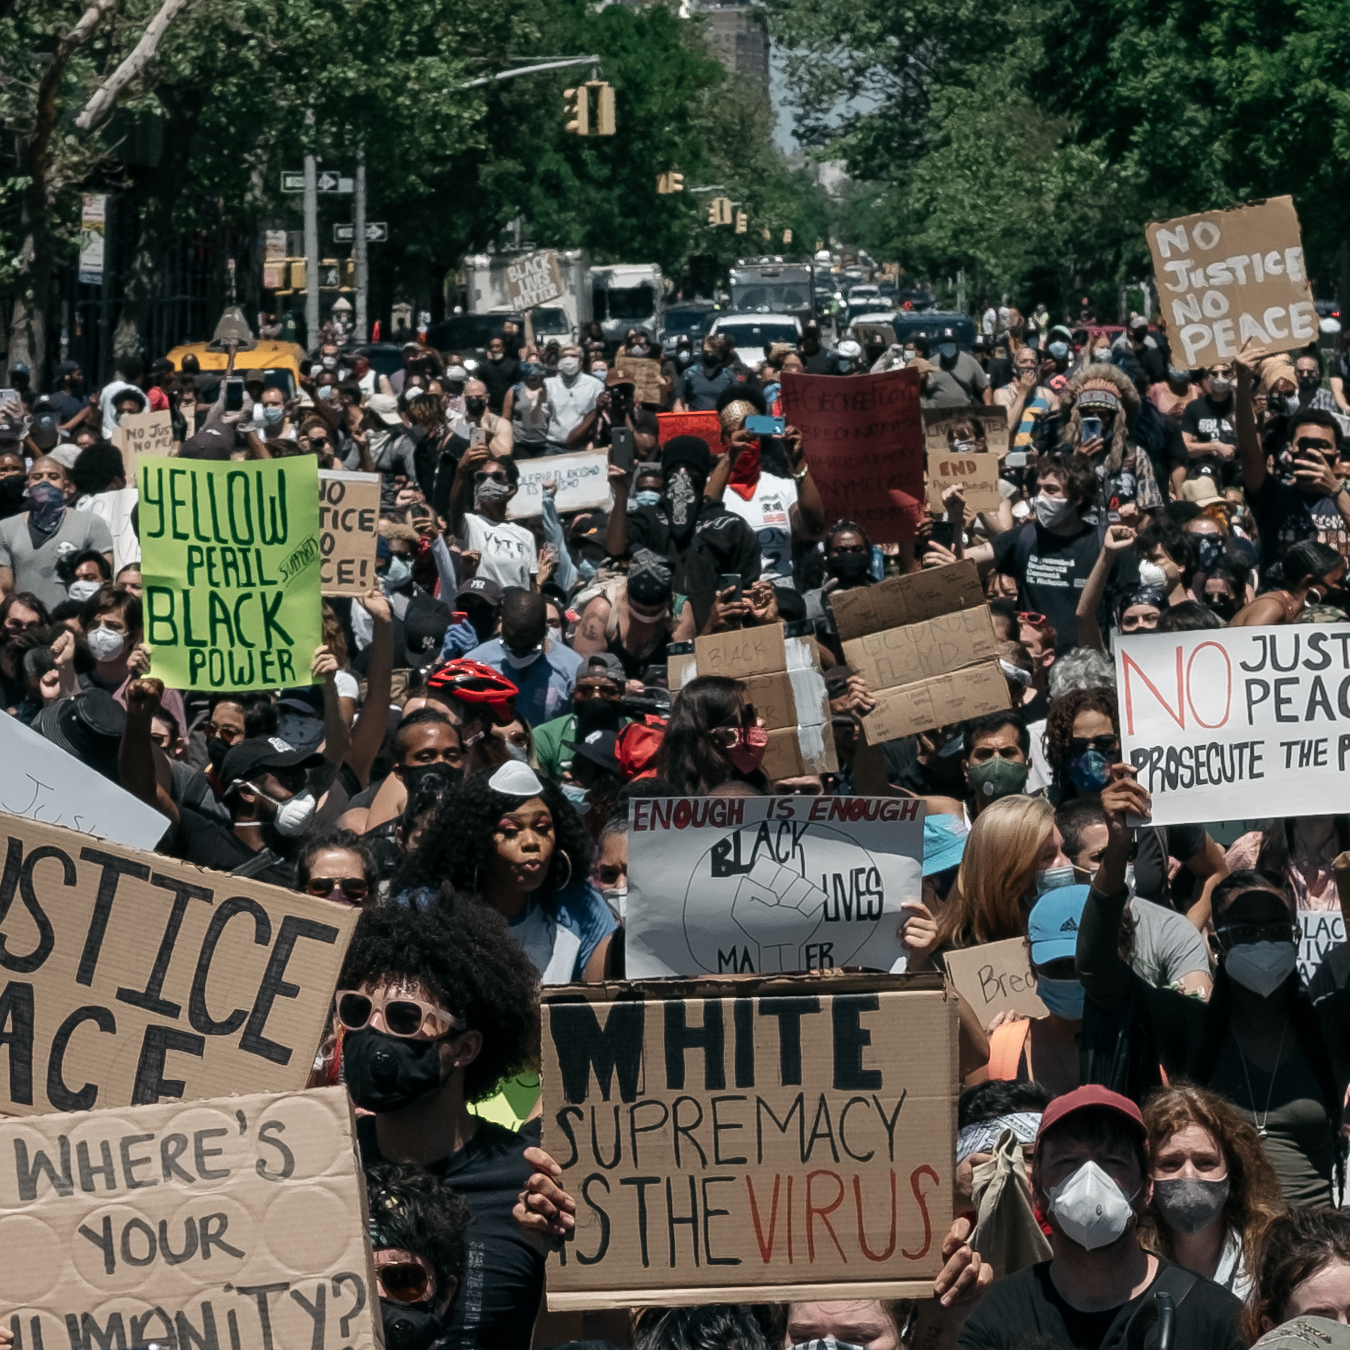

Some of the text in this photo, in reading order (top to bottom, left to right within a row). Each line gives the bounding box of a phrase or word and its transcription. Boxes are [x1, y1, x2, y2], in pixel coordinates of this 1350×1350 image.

[1156, 221, 1221, 257] NO
[507, 256, 551, 282] BLACK
[519, 271, 550, 292] LIVES
[513, 284, 558, 310] MATTER
[1172, 290, 1230, 325] NO
[1179, 302, 1315, 366] PEACE
[125, 427, 145, 441] NO
[133, 440, 149, 453] NO
[938, 460, 977, 478] END
[143, 467, 287, 547] YELLOW
[187, 546, 280, 587] PERIL
[145, 587, 296, 649] BLACK
[188, 649, 296, 688] POWER
[708, 643, 766, 671] BLACK
[1120, 641, 1233, 737] NO
[1129, 740, 1266, 794] PROSECUTE
[1279, 739, 1330, 769] THE
[632, 797, 921, 833] ENOUGH IS ENOUGH
[709, 819, 812, 879] BLACK
[821, 866, 884, 923] LIVES
[715, 942, 834, 974] MATTER
[547, 992, 885, 1104] WHITE
[553, 1087, 908, 1171] SUPREMACY
[13, 1109, 297, 1202] WHERE'S
[618, 1175, 743, 1269] THE
[744, 1164, 940, 1266] VIRUS
[77, 1211, 247, 1275] YOUR
